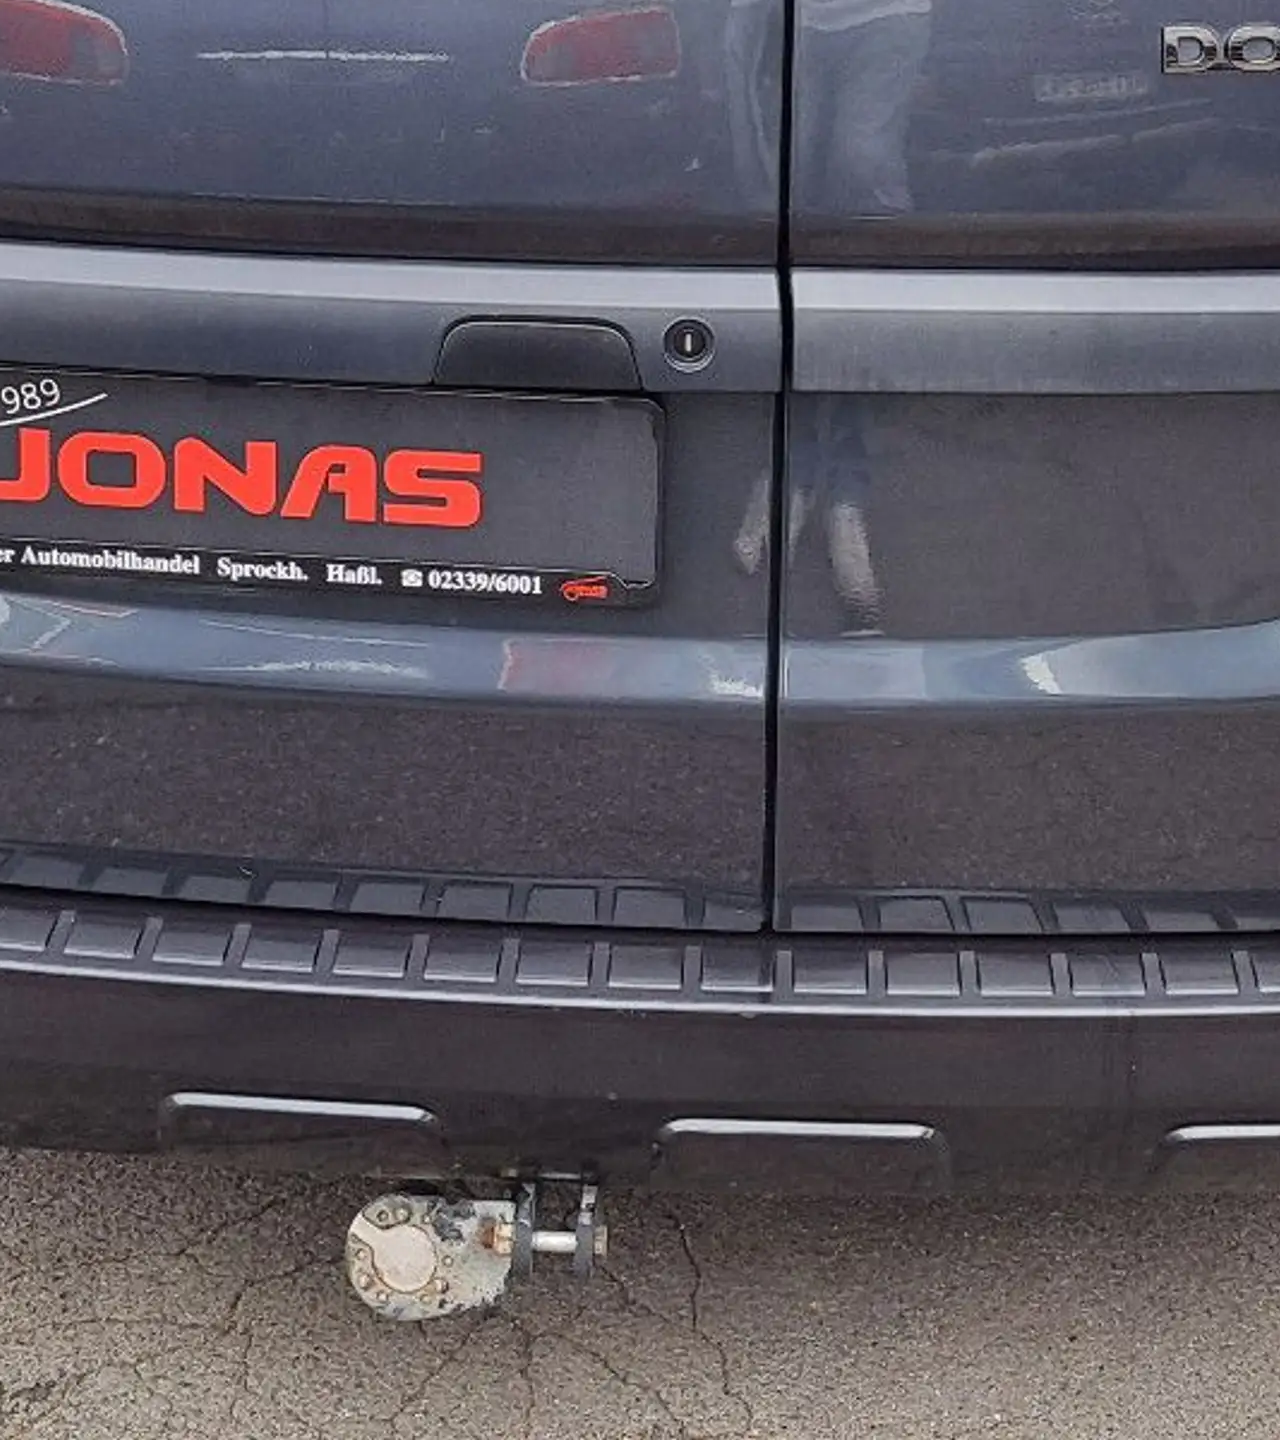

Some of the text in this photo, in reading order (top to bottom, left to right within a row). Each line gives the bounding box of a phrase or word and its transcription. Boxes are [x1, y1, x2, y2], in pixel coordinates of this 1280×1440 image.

[20, 544, 201, 575] Automobilhandel
[216, 557, 308, 582] Sprockh.
[428, 570, 543, 595] 02339/6001
